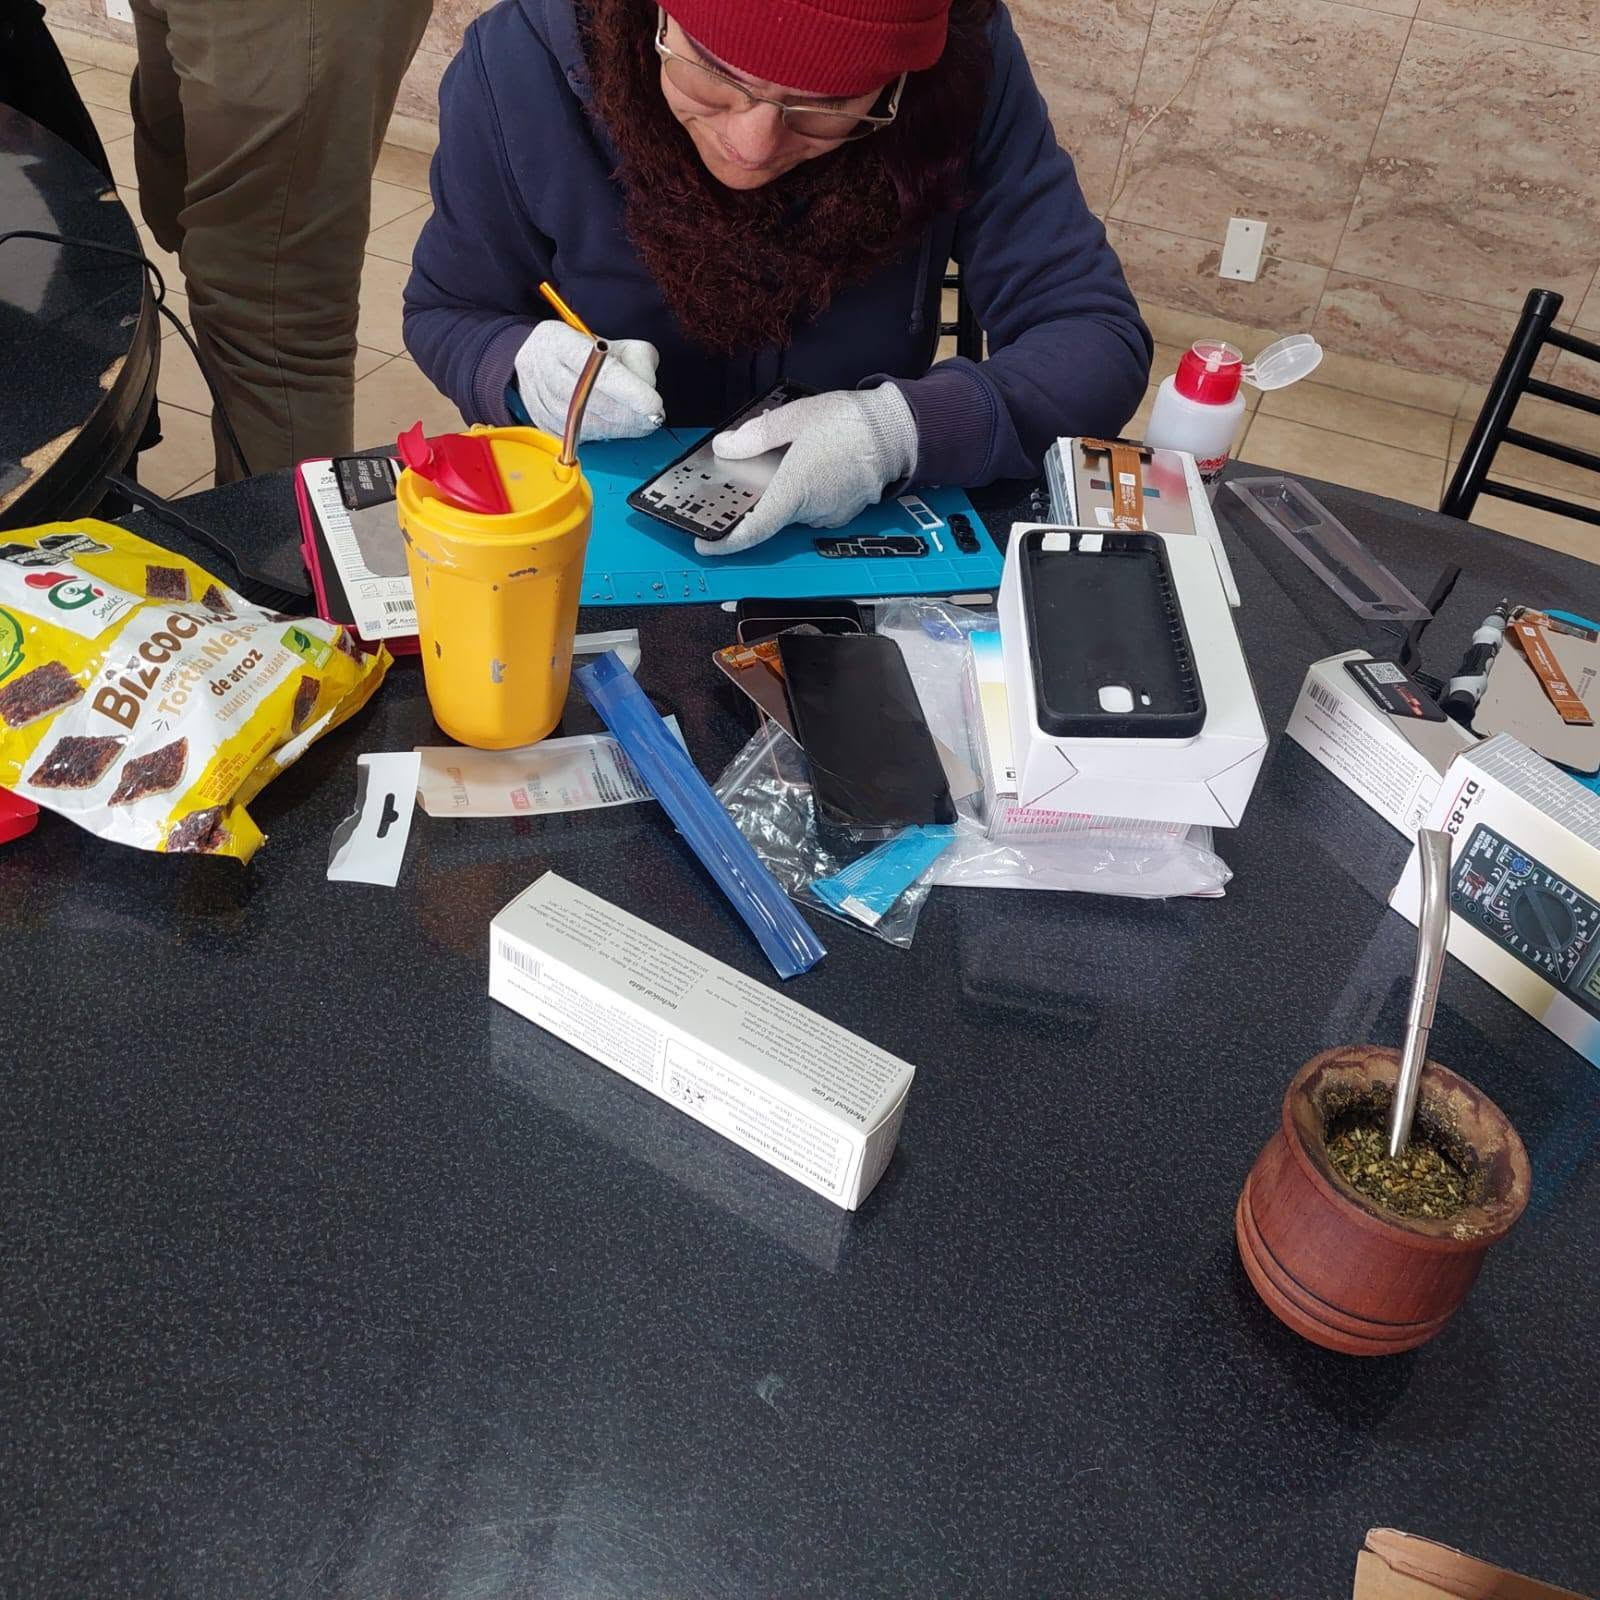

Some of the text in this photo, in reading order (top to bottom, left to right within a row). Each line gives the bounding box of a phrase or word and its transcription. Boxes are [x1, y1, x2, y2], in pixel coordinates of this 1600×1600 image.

[209, 679, 231, 697] de
[226, 648, 264, 683] arroz
[1446, 779, 1480, 835] DT-83
[625, 979, 678, 1011] technical data
[809, 1085, 826, 1098] use
[822, 1094, 835, 1104] of
[833, 1099, 868, 1123] Method
[734, 1123, 770, 1151] attention
[771, 1145, 804, 1171] needing
